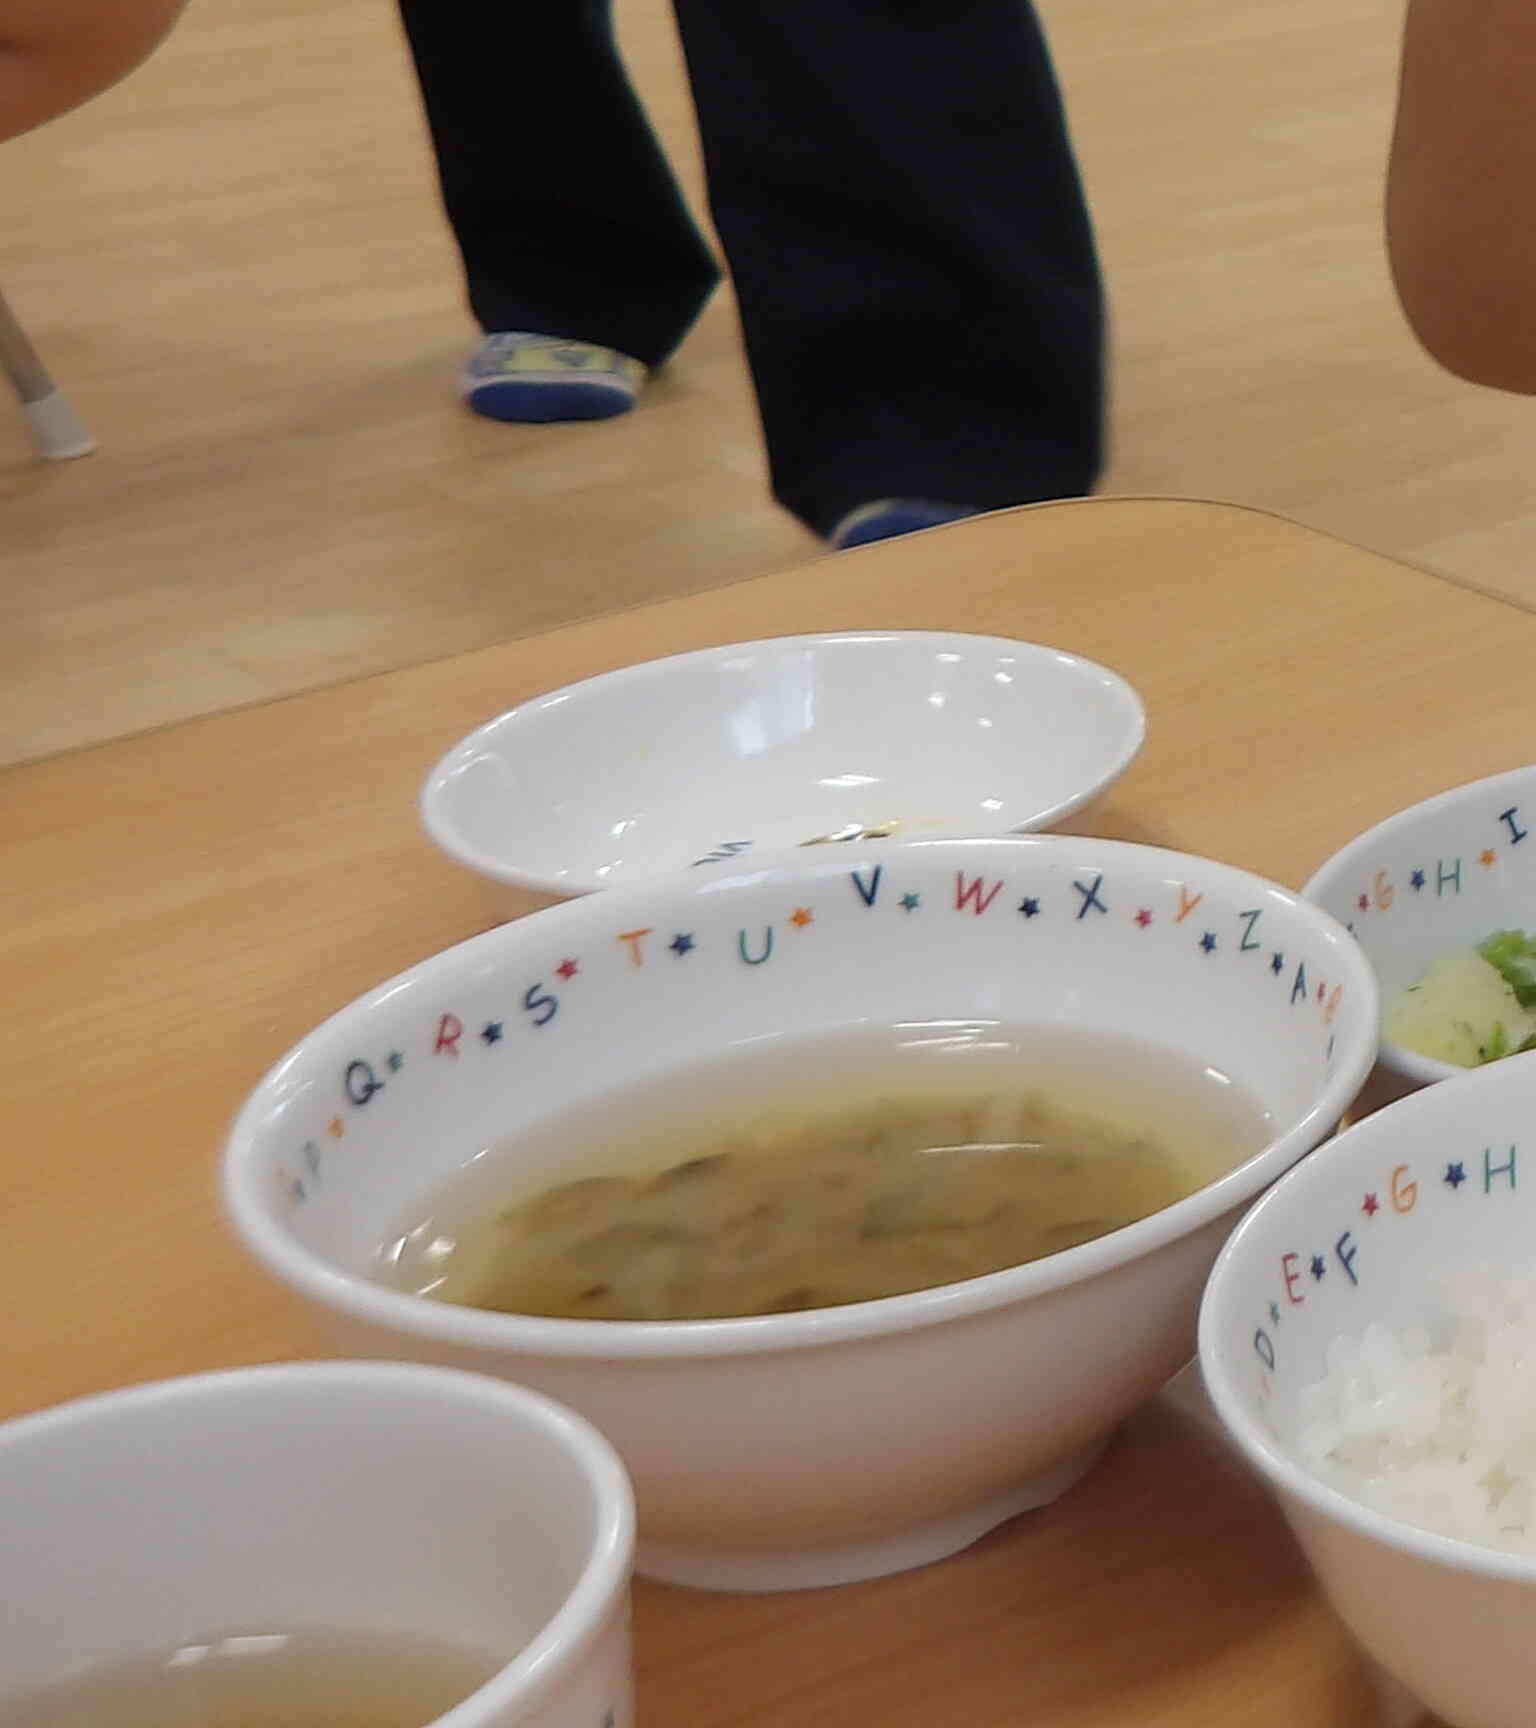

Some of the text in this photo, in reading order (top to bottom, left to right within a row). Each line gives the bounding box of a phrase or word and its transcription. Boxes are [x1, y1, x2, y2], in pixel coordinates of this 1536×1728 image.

[1435, 859, 1461, 895] H
[1500, 806, 1529, 844] I
[345, 1058, 383, 1105] Q
[434, 1014, 463, 1056] R
[524, 984, 558, 1025] S
[619, 929, 653, 965] T
[740, 926, 772, 963] U
[851, 865, 882, 906] V
[954, 872, 1004, 914] W
[1073, 874, 1108, 919] X
[1176, 886, 1203, 922] Y
[1239, 910, 1262, 951] Z
[1282, 1253, 1304, 1303] E
[1336, 1232, 1358, 1285] F
[1390, 1165, 1417, 1212] G
[1484, 1145, 1516, 1192] H
